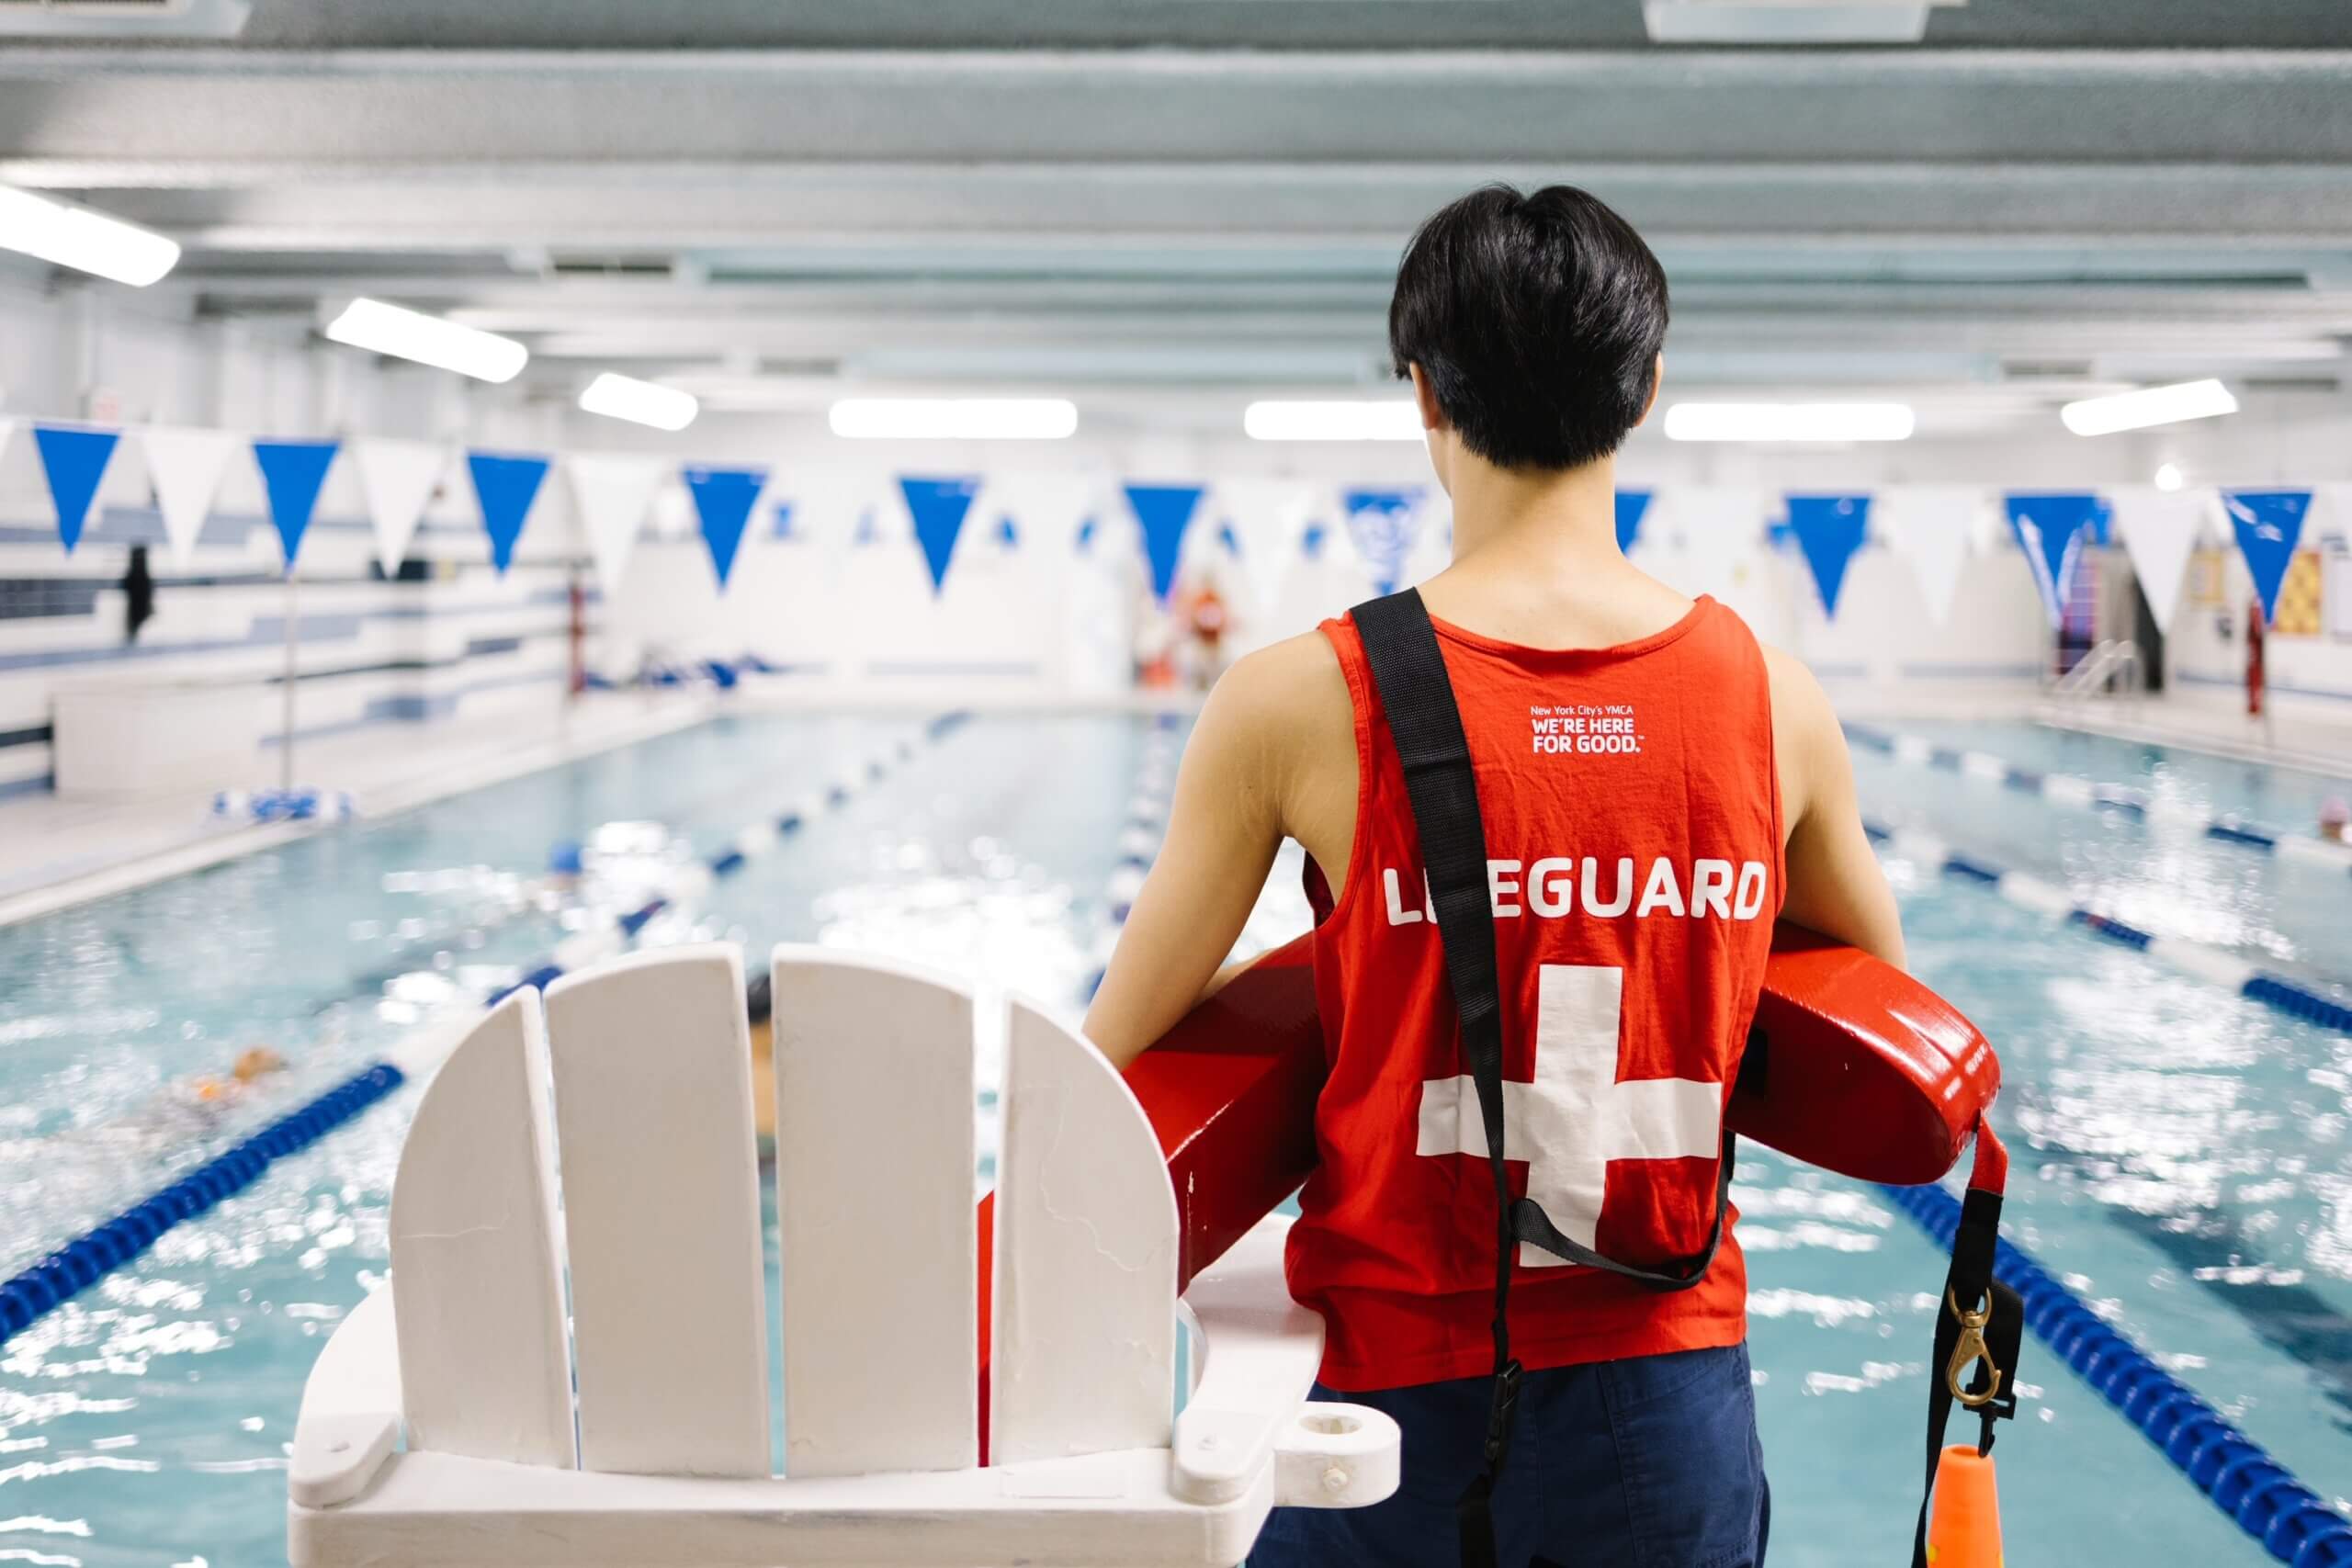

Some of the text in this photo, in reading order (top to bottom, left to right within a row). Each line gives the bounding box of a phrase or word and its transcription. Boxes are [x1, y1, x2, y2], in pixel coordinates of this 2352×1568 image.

[1531, 705, 1551, 716] New
[1555, 705, 1575, 716] York
[1606, 705, 1633, 715] YMCA
[1532, 718, 1634, 734] WE'RE HERE
[1533, 736, 1572, 753] FOR
[1383, 857, 1766, 925] LEGUARD
